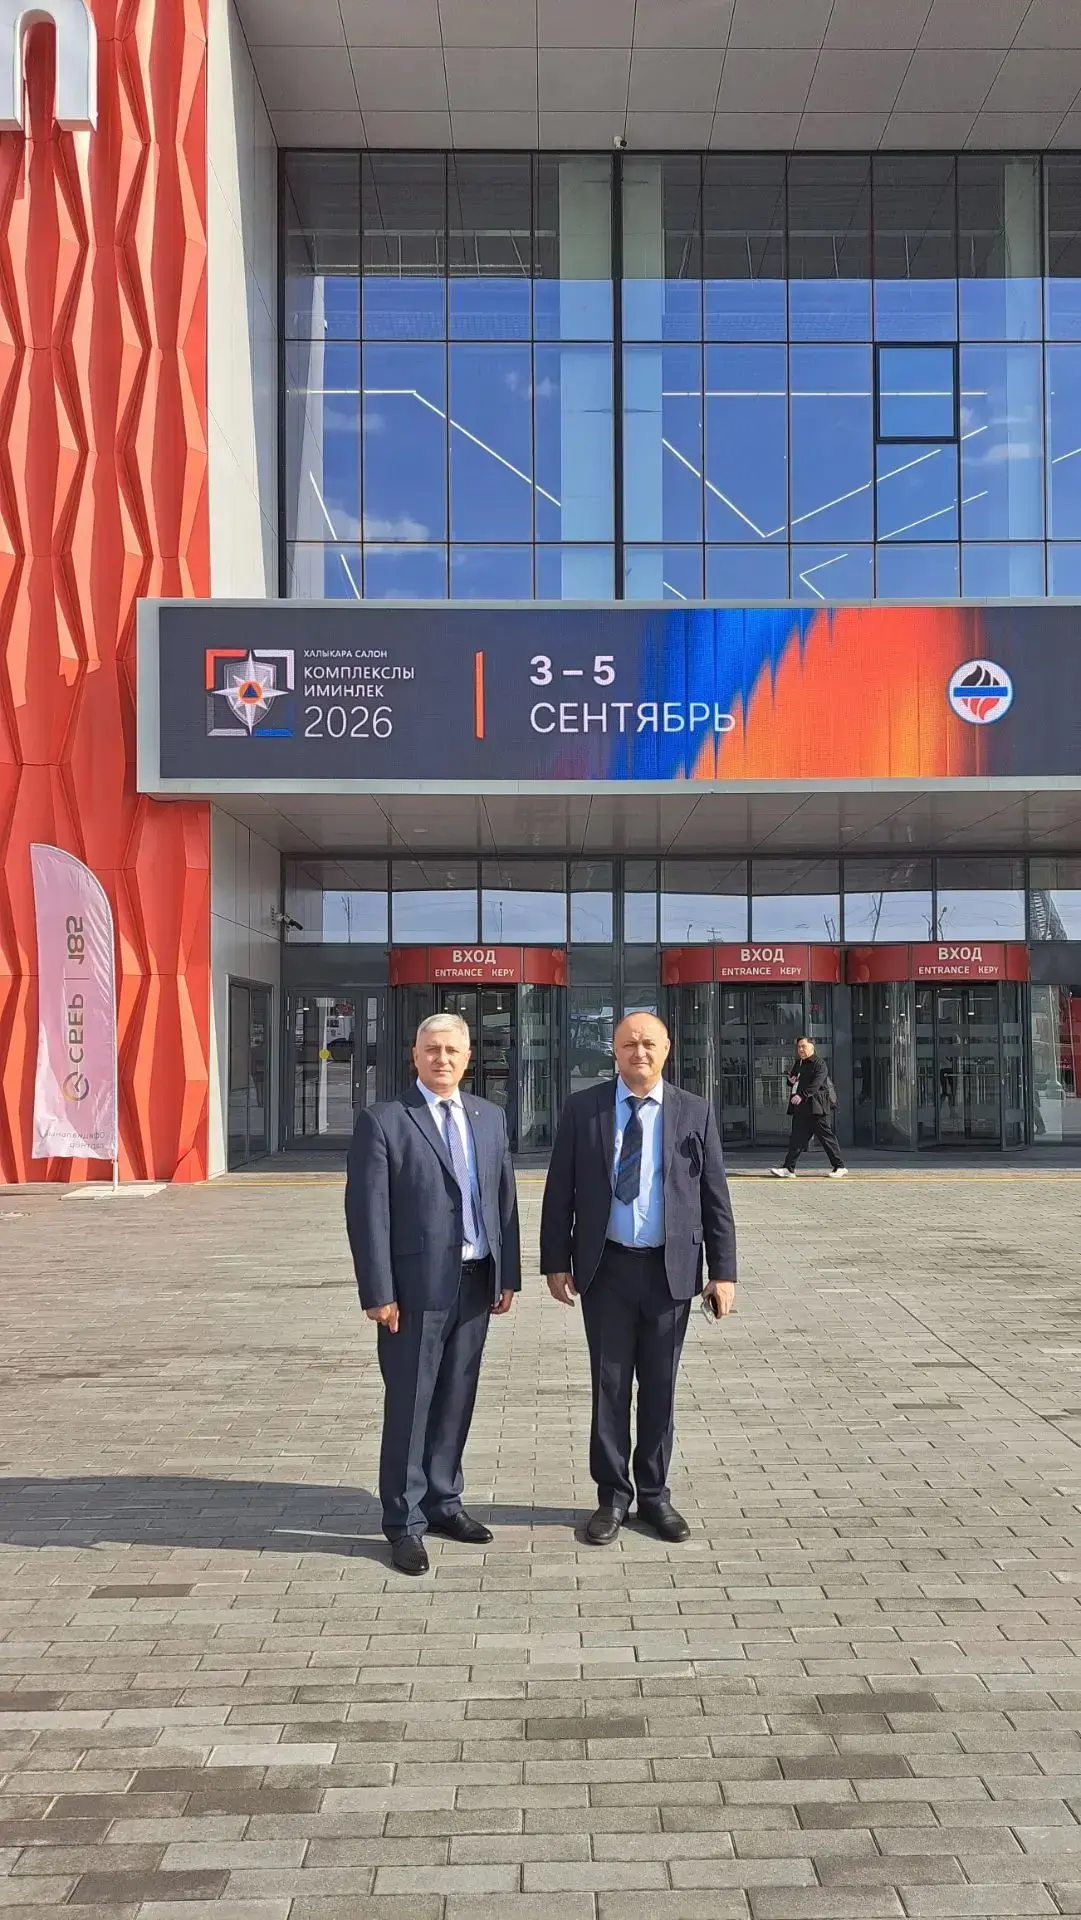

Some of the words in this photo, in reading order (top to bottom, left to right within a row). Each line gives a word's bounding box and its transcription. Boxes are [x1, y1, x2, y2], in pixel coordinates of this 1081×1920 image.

[303, 649, 353, 658] ХАЛЫКАРА
[355, 649, 388, 658] САЛОН
[303, 666, 415, 680] КОМПЛЕКСЛЫ
[529, 655, 553, 686] 3
[593, 655, 616, 686] 5
[303, 684, 385, 698] ИМИНЛЕК
[304, 705, 393, 738] 2026
[529, 702, 736, 733] СЕНТЯБРЬ
[452, 949, 497, 965] ВХОД
[740, 948, 785, 963] ВХОД
[938, 947, 983, 962] ВХОД
[435, 968, 483, 977] ENTRANCE
[721, 967, 772, 976] ENTRANCE
[918, 965, 970, 975] ENTRANCE
